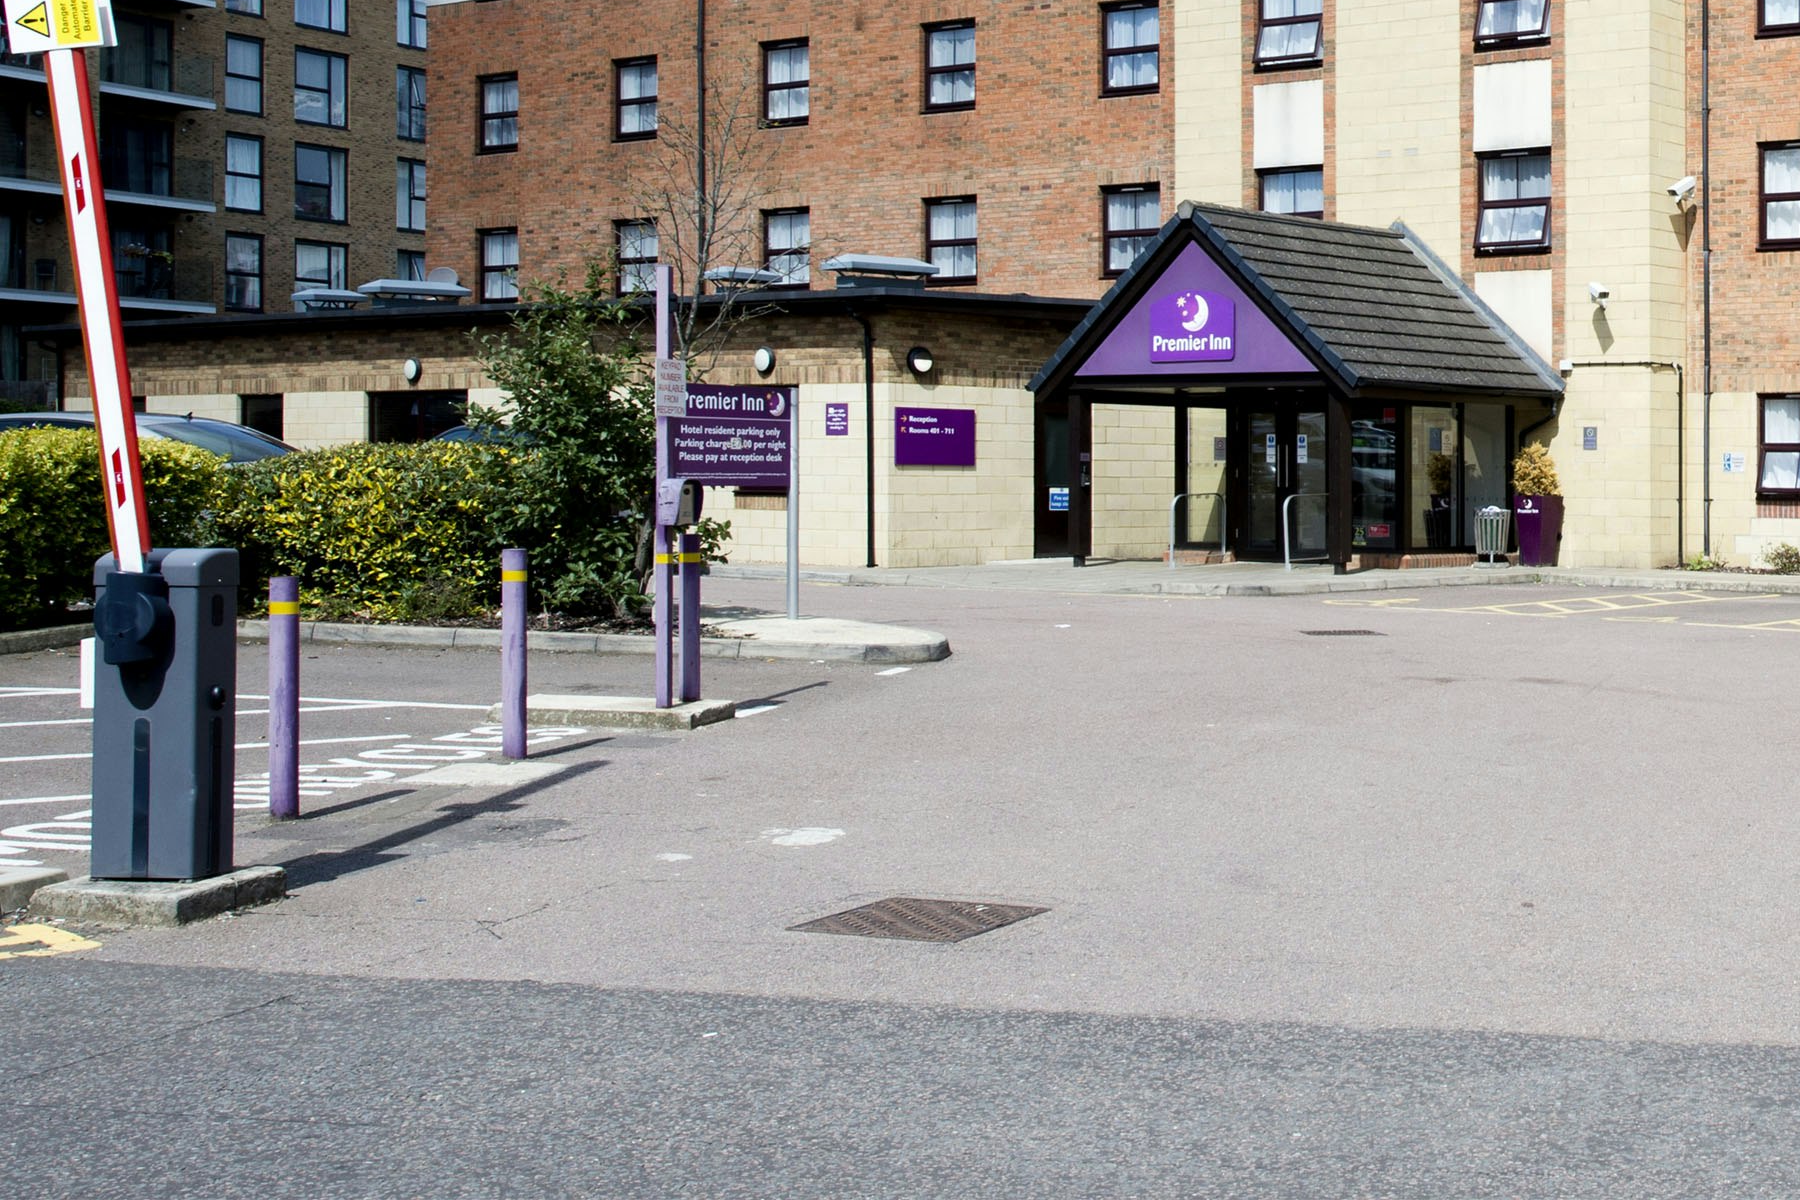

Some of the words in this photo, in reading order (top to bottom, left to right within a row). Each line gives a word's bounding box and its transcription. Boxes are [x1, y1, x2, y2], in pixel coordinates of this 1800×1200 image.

[60, 3, 70, 33] Danger
[81, 1, 91, 32] Barrier
[1153, 334, 1208, 352] Premier
[1209, 333, 1231, 350] Inn
[660, 372, 682, 381] NUMBER
[658, 383, 685, 393] AVAILABLE
[664, 394, 679, 403] FROM
[742, 393, 764, 411] Inn
[909, 415, 938, 424] Reception
[680, 424, 703, 434] Hotel
[704, 425, 735, 435] resident
[736, 427, 764, 438] parking
[765, 427, 781, 438] only
[674, 437, 705, 450] Parking
[705, 439, 731, 451] charge
[753, 441, 766, 451] per
[767, 440, 786, 451] night
[679, 451, 704, 461] Please
[705, 453, 719, 463] pay
[720, 453, 728, 461] at
[729, 453, 764, 464] reception
[766, 453, 783, 462] desk
[1354, 527, 1364, 536] 25
